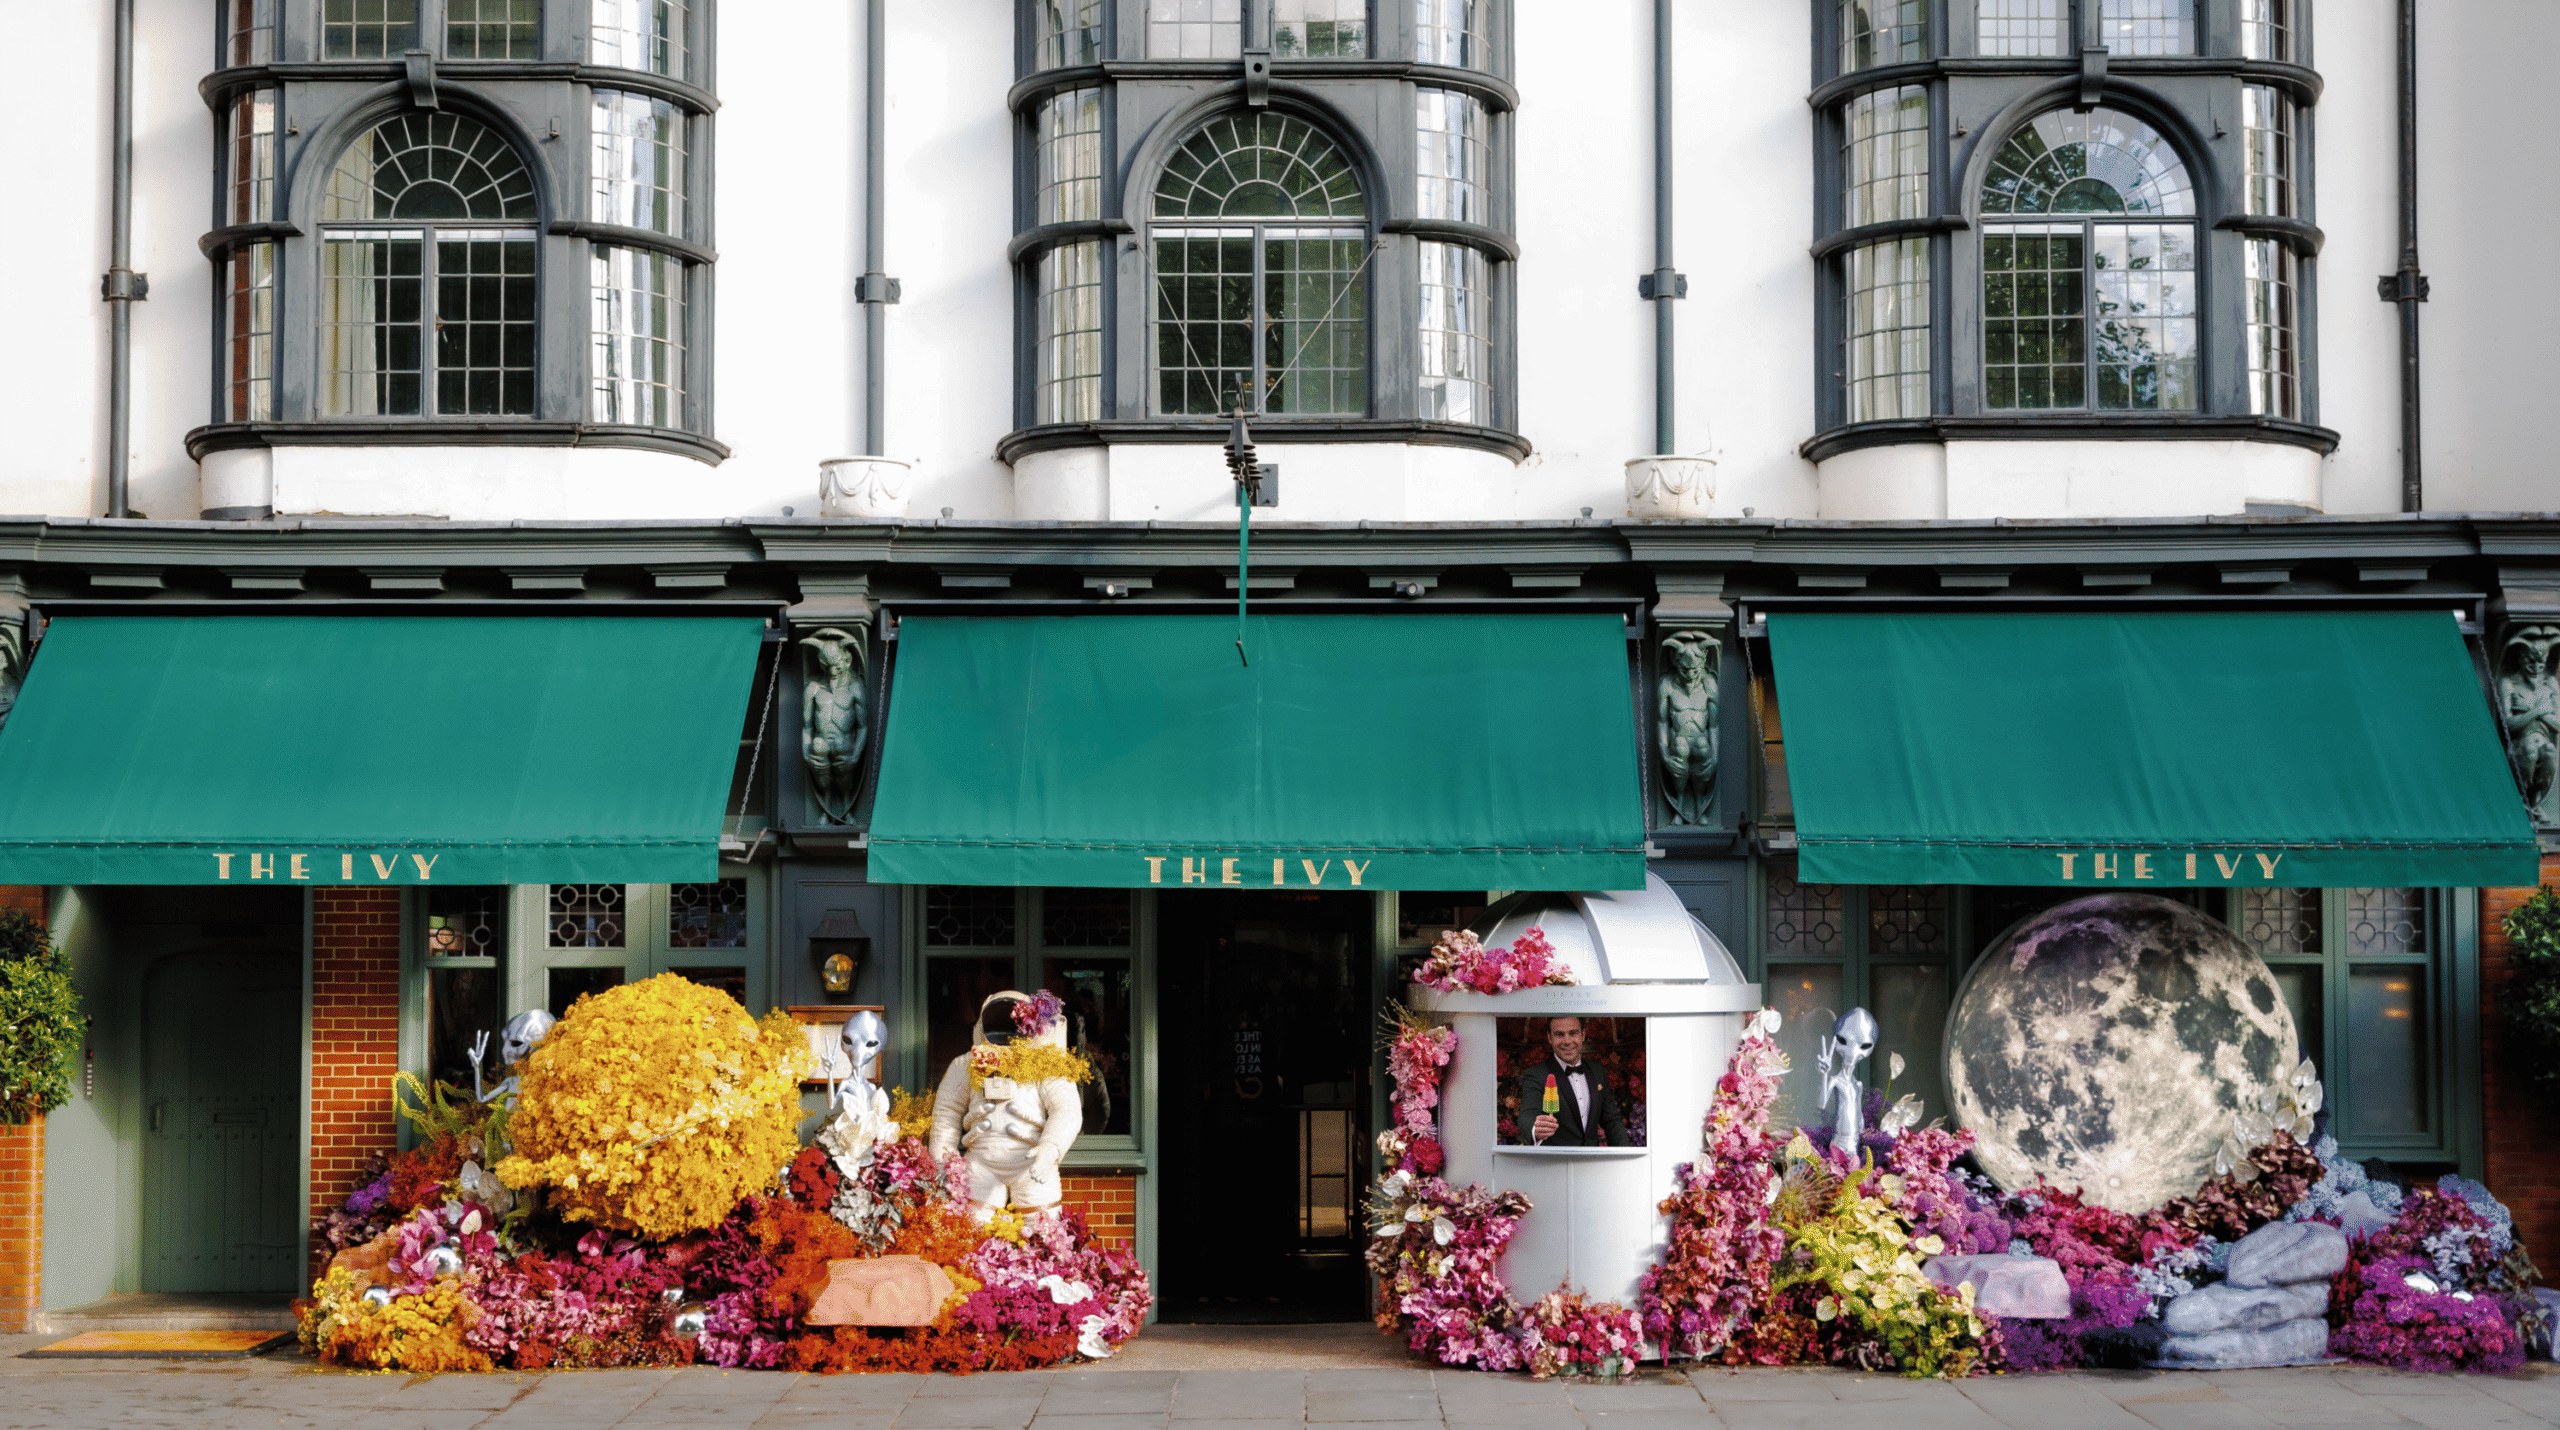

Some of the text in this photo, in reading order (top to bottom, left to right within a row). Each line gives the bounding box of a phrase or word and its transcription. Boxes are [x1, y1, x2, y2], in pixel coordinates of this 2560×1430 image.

[213, 853, 440, 880] THE IVY
[1144, 856, 1371, 886] THE IVY
[2057, 853, 2283, 879] THE IVY
